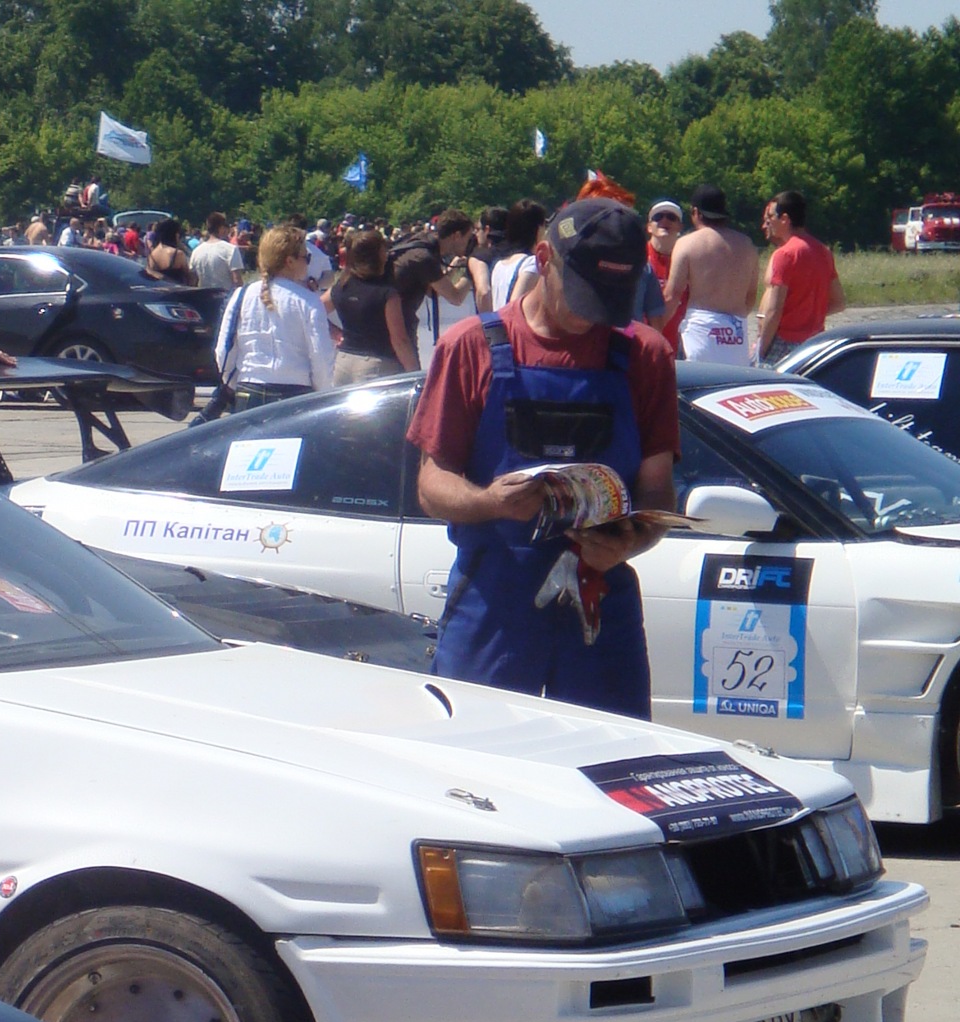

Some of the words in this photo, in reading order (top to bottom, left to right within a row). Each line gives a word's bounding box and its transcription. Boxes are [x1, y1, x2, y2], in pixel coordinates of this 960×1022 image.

[271, 472, 291, 481] Auto
[123, 520, 157, 537] ПП
[163, 521, 250, 542] Капітан
[722, 650, 774, 692] 52
[738, 702, 776, 714] UNIQA
